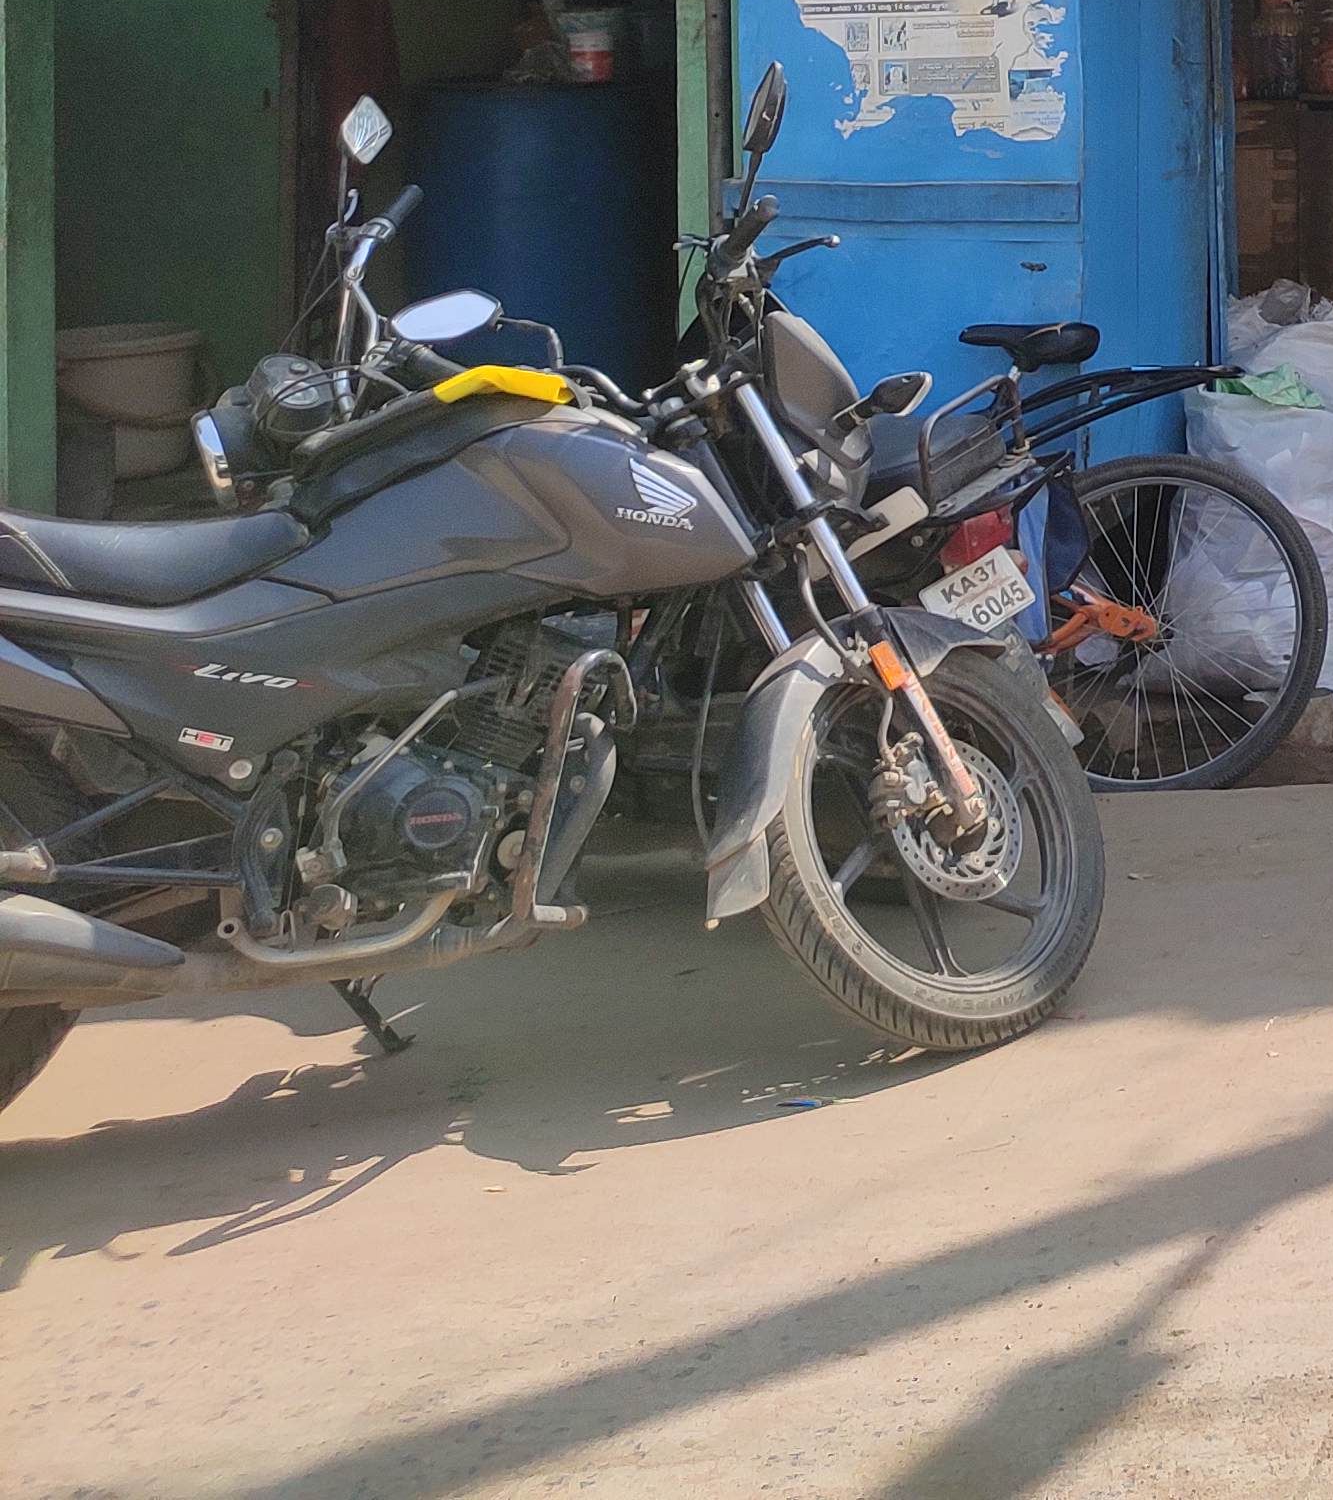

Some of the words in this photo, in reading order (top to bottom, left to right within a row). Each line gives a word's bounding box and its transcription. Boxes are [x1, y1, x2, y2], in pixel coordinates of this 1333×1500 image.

[616, 507, 695, 531] HONDA
[971, 580, 1026, 626] 6045
[408, 813, 463, 827] HONDA
